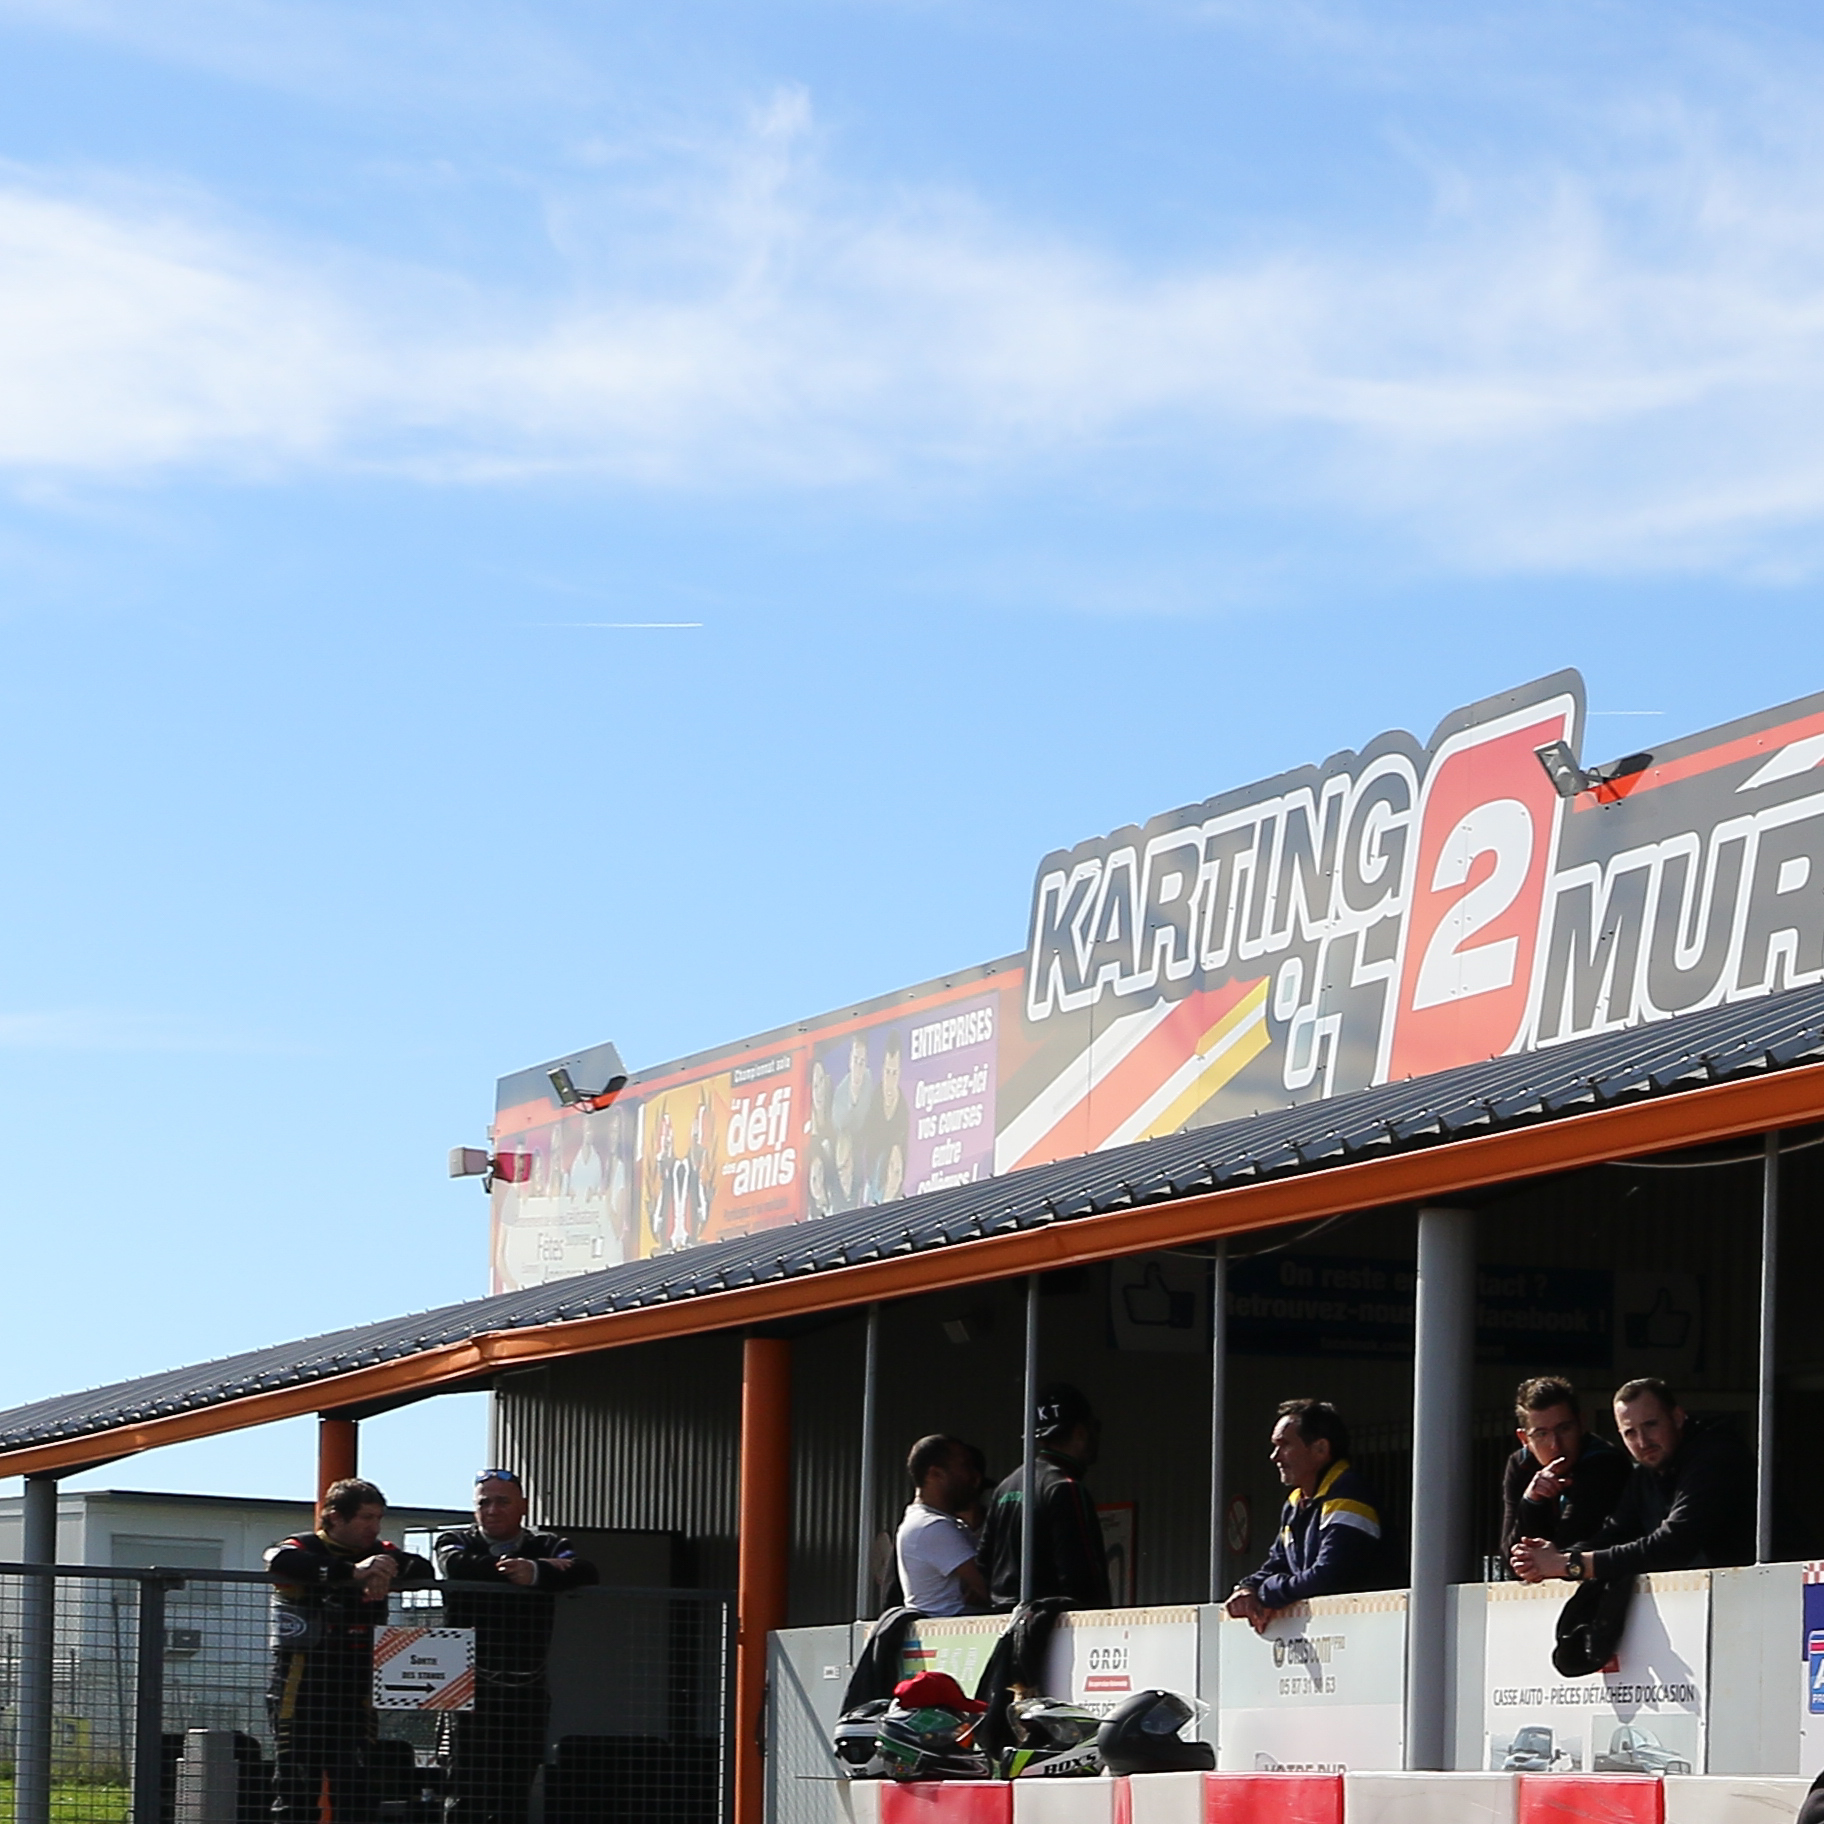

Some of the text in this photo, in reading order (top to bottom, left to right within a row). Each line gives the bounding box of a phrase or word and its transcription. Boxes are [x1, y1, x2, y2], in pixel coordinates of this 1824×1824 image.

[1027, 752, 1418, 1022] KARTING
[1413, 799, 1536, 1011] 2
[911, 1007, 994, 1062] ENTREPRISES
[915, 1063, 989, 1112] Organisez-ici
[727, 1086, 792, 1156] défi
[917, 1103, 983, 1140] vos courses
[733, 1143, 796, 1196] amis
[931, 1138, 962, 1168] entre
[1089, 1648, 1128, 1670] ORDI
[1493, 1688, 1518, 1706] CASSE
[1519, 1688, 1543, 1705] AUTO
[1551, 1683, 1581, 1705] PIÈCES
[1583, 1682, 1634, 1705] DÉTACHÉES
[1635, 1683, 1695, 1703] D'OCCASION
